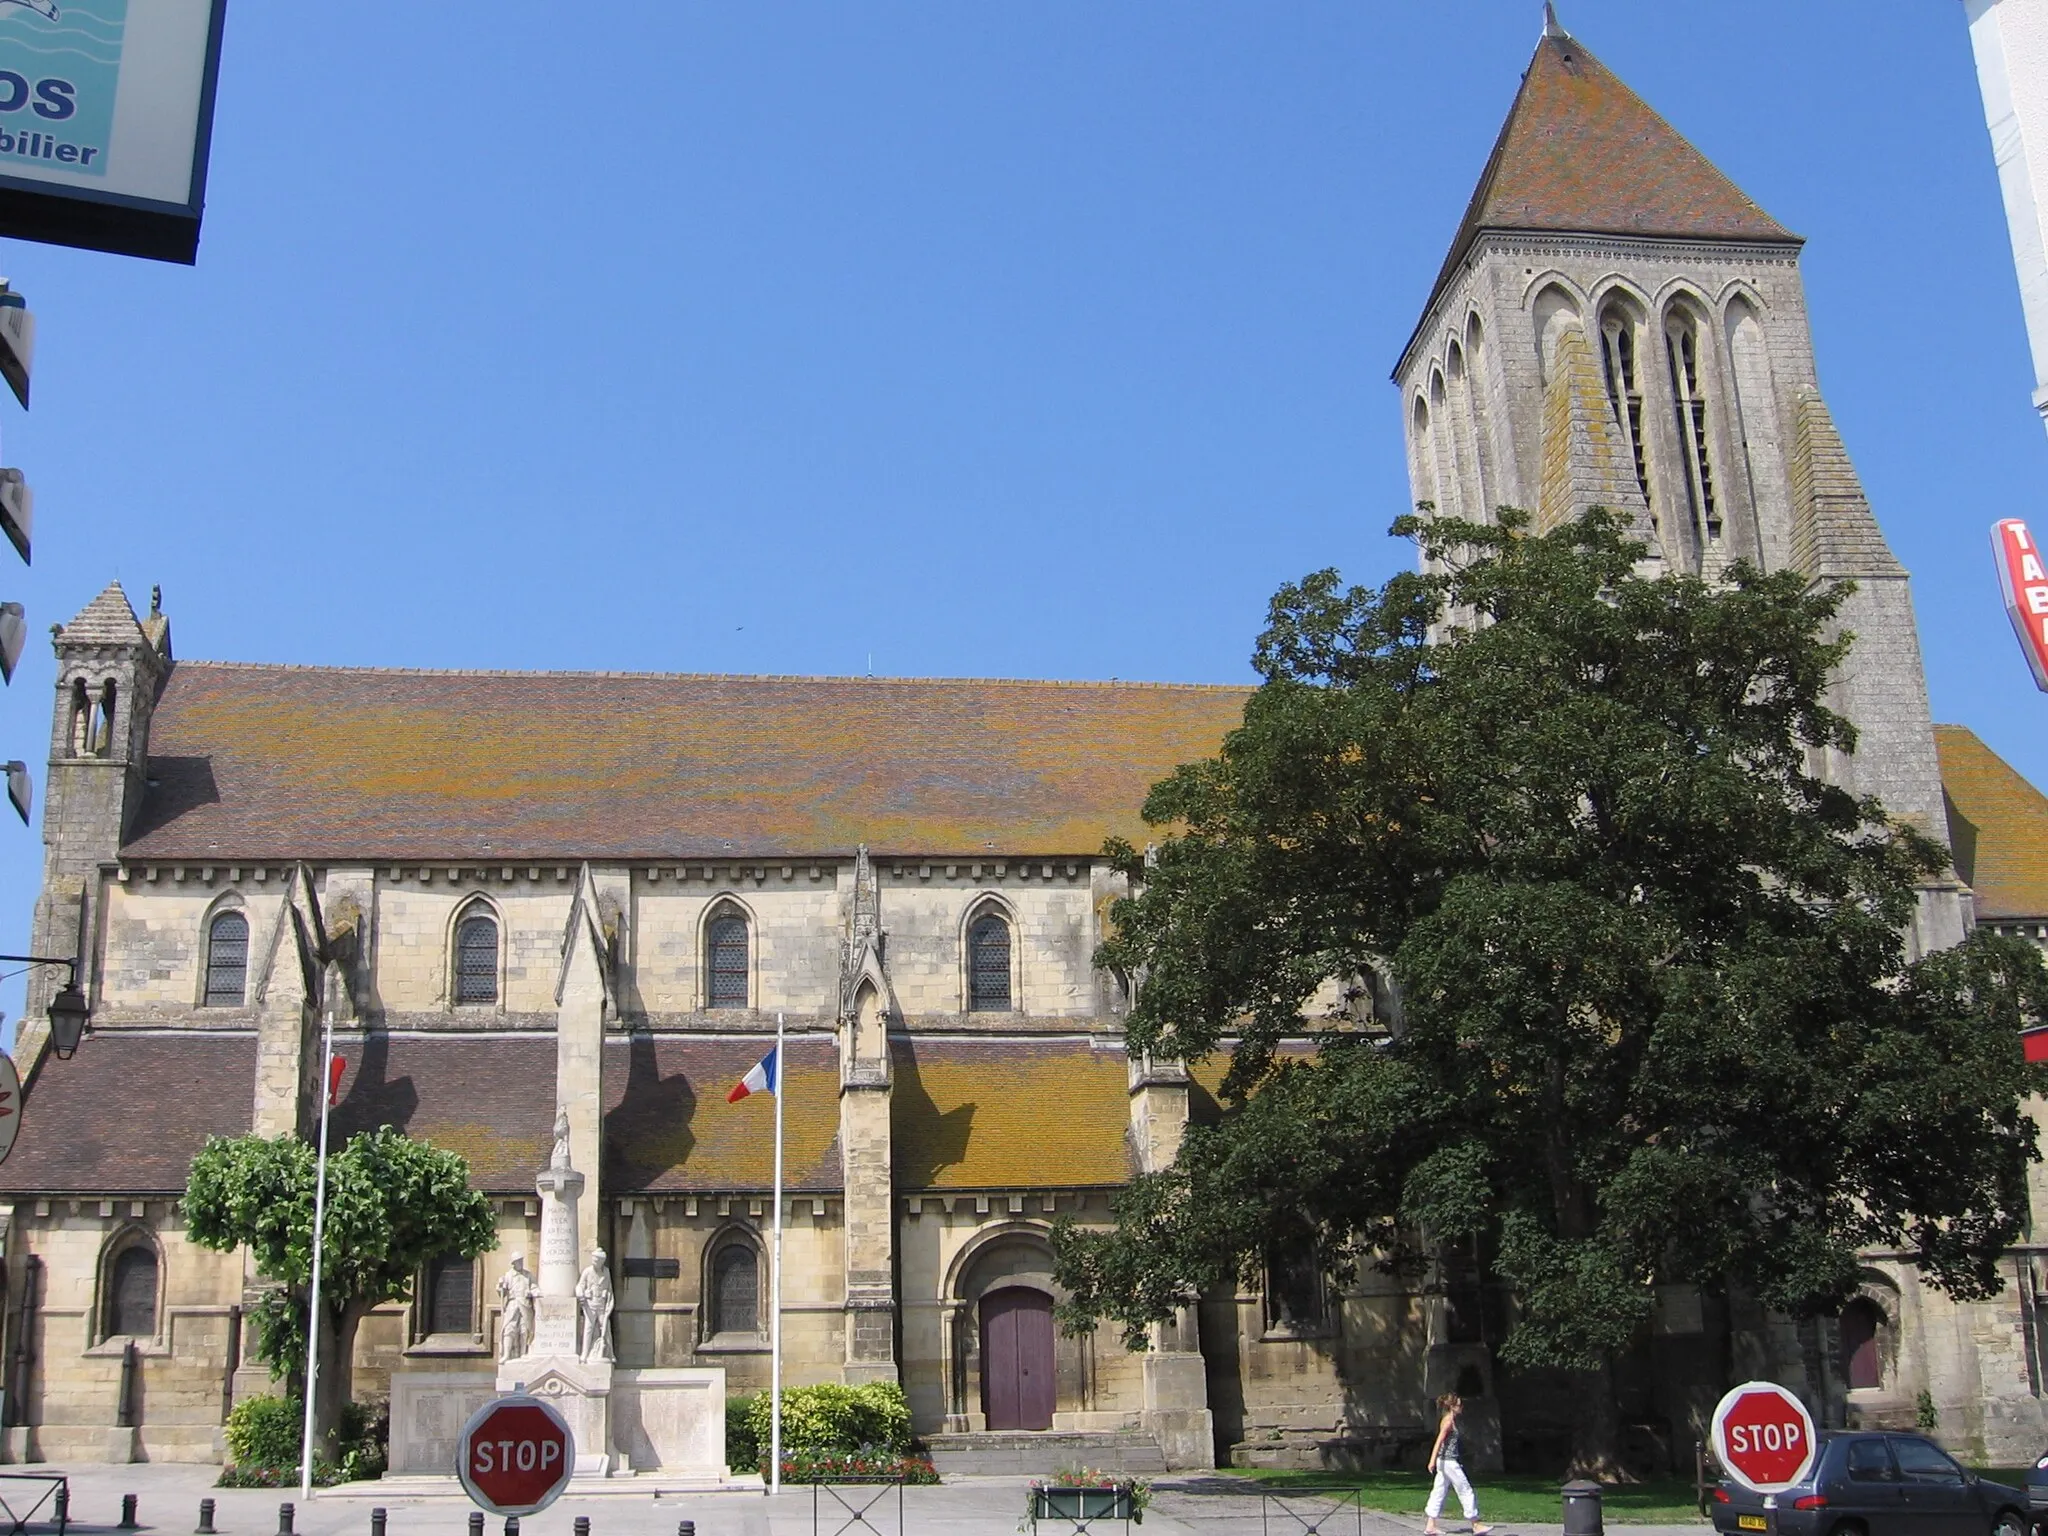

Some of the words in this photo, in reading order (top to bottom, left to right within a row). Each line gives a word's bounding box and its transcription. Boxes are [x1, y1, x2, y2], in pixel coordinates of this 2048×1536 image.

[2007, 523, 2048, 645] TAB
[1731, 1422, 1800, 1453] STOP
[474, 1440, 560, 1473] STOP
